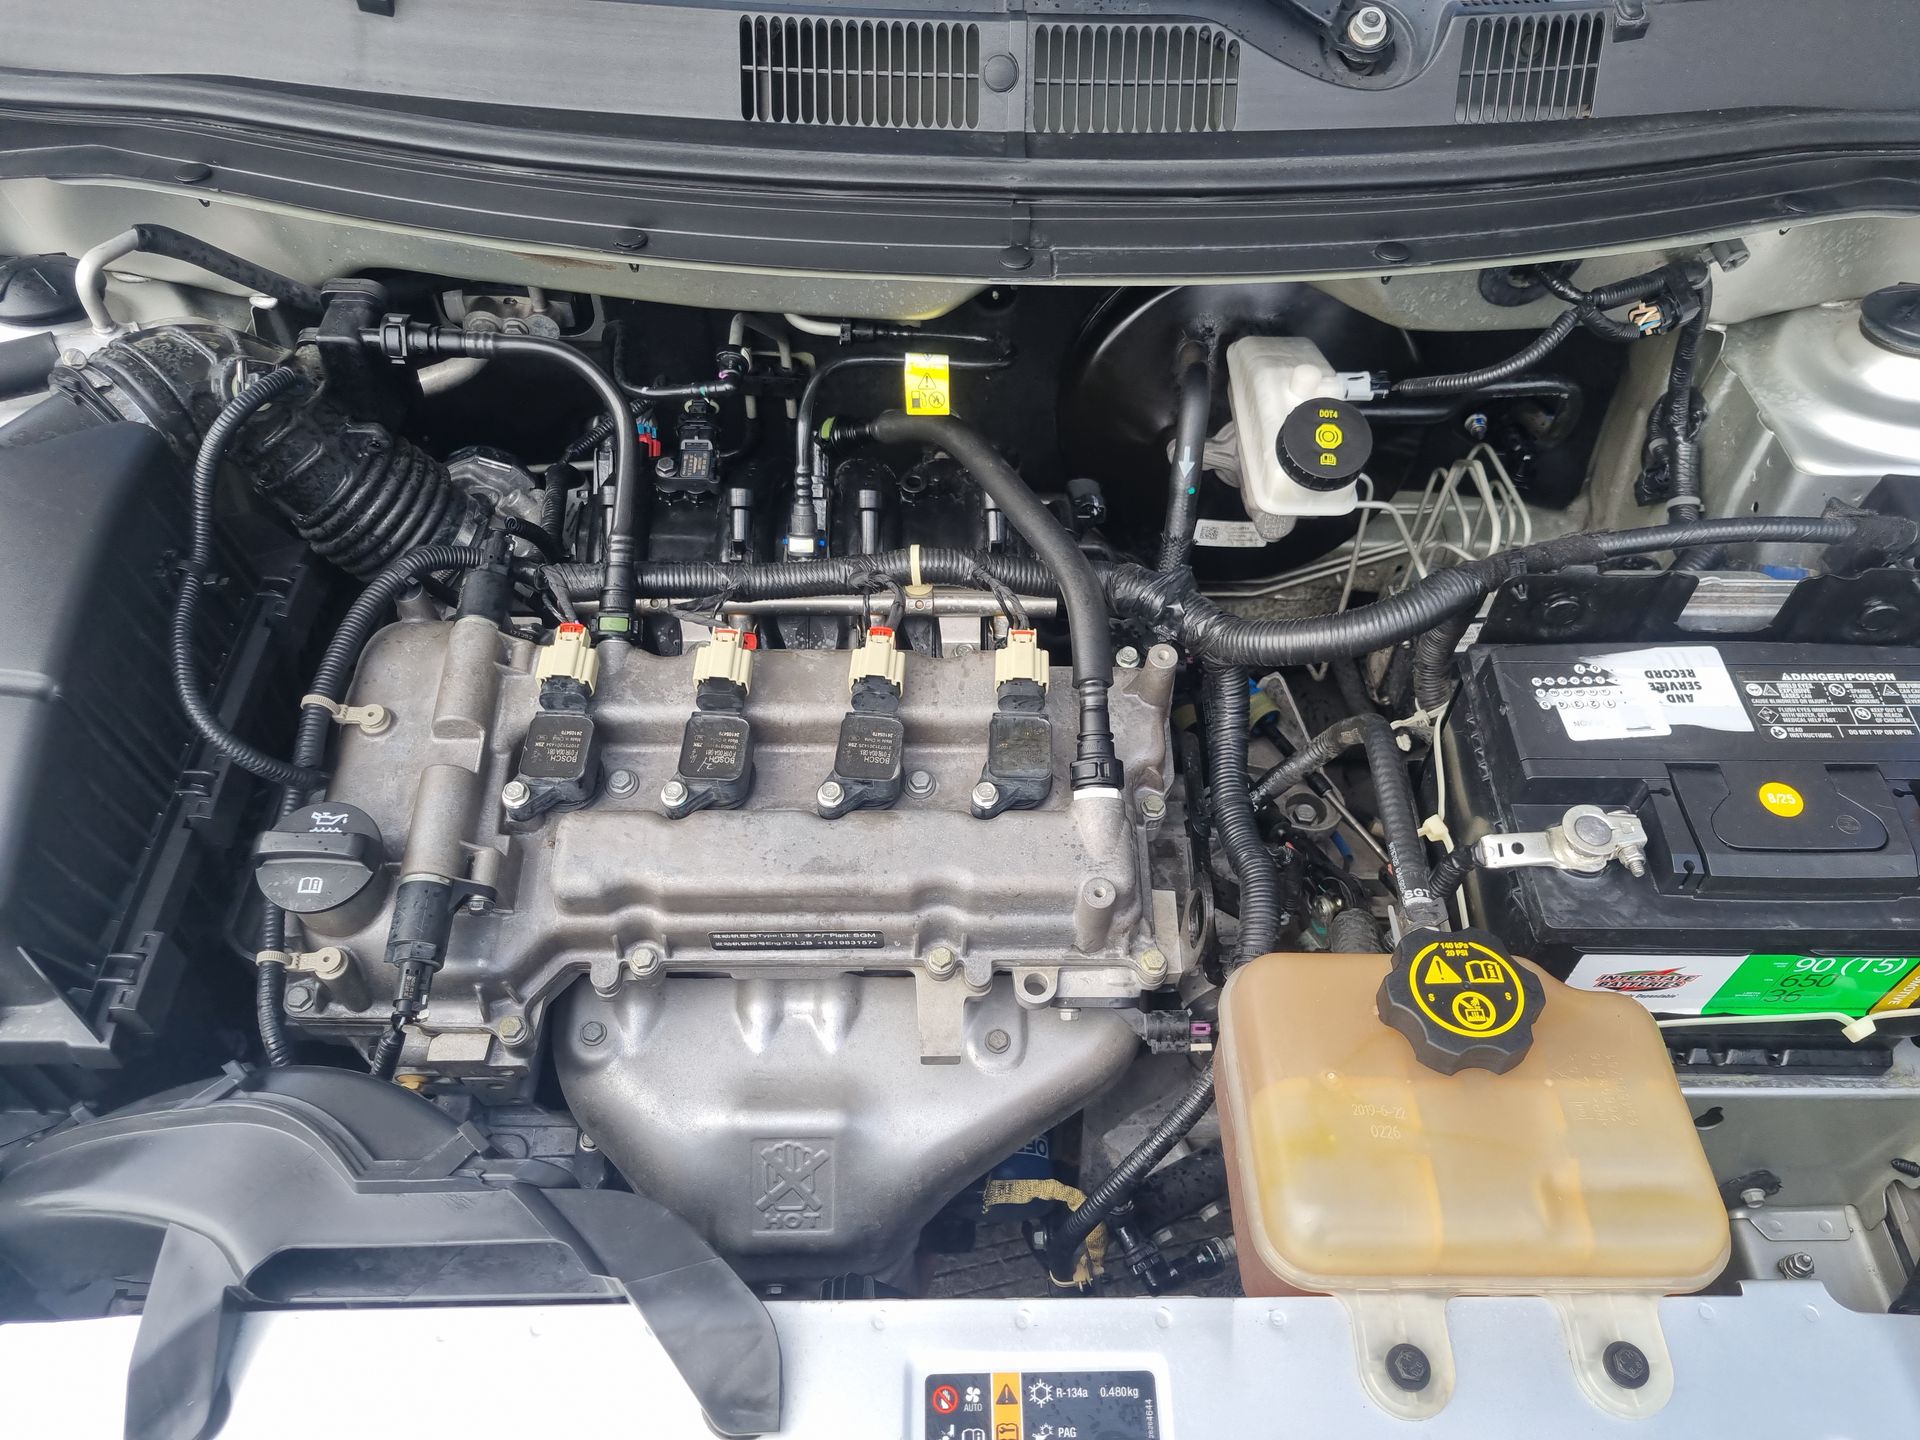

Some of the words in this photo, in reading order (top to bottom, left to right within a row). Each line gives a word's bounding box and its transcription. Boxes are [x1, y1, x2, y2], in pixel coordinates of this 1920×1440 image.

[1319, 410, 1338, 418] DOT4
[1644, 669, 1696, 679] RECORD
[1791, 673, 1896, 681] DANGER/POISON
[1650, 681, 1702, 693] SERVICE
[1666, 693, 1694, 703] AND
[550, 754, 577, 763] BOSCH
[709, 755, 735, 764] BOSCH
[864, 756, 890, 764] BOSCH
[1767, 793, 1796, 805] 8/25
[1404, 888, 1430, 899] SGT
[1793, 957, 1836, 973] 90
[1841, 957, 1908, 976] (T5)
[1780, 974, 1839, 988] 650
[1428, 994, 1435, 1002] S
[1504, 992, 1512, 1000] S
[1764, 989, 1805, 1002] 36
[764, 1212, 820, 1229] HOT
[1056, 1388, 1088, 1398] R-134a
[964, 1404, 983, 1412] AUTO
[1058, 1427, 1076, 1438] PAG
